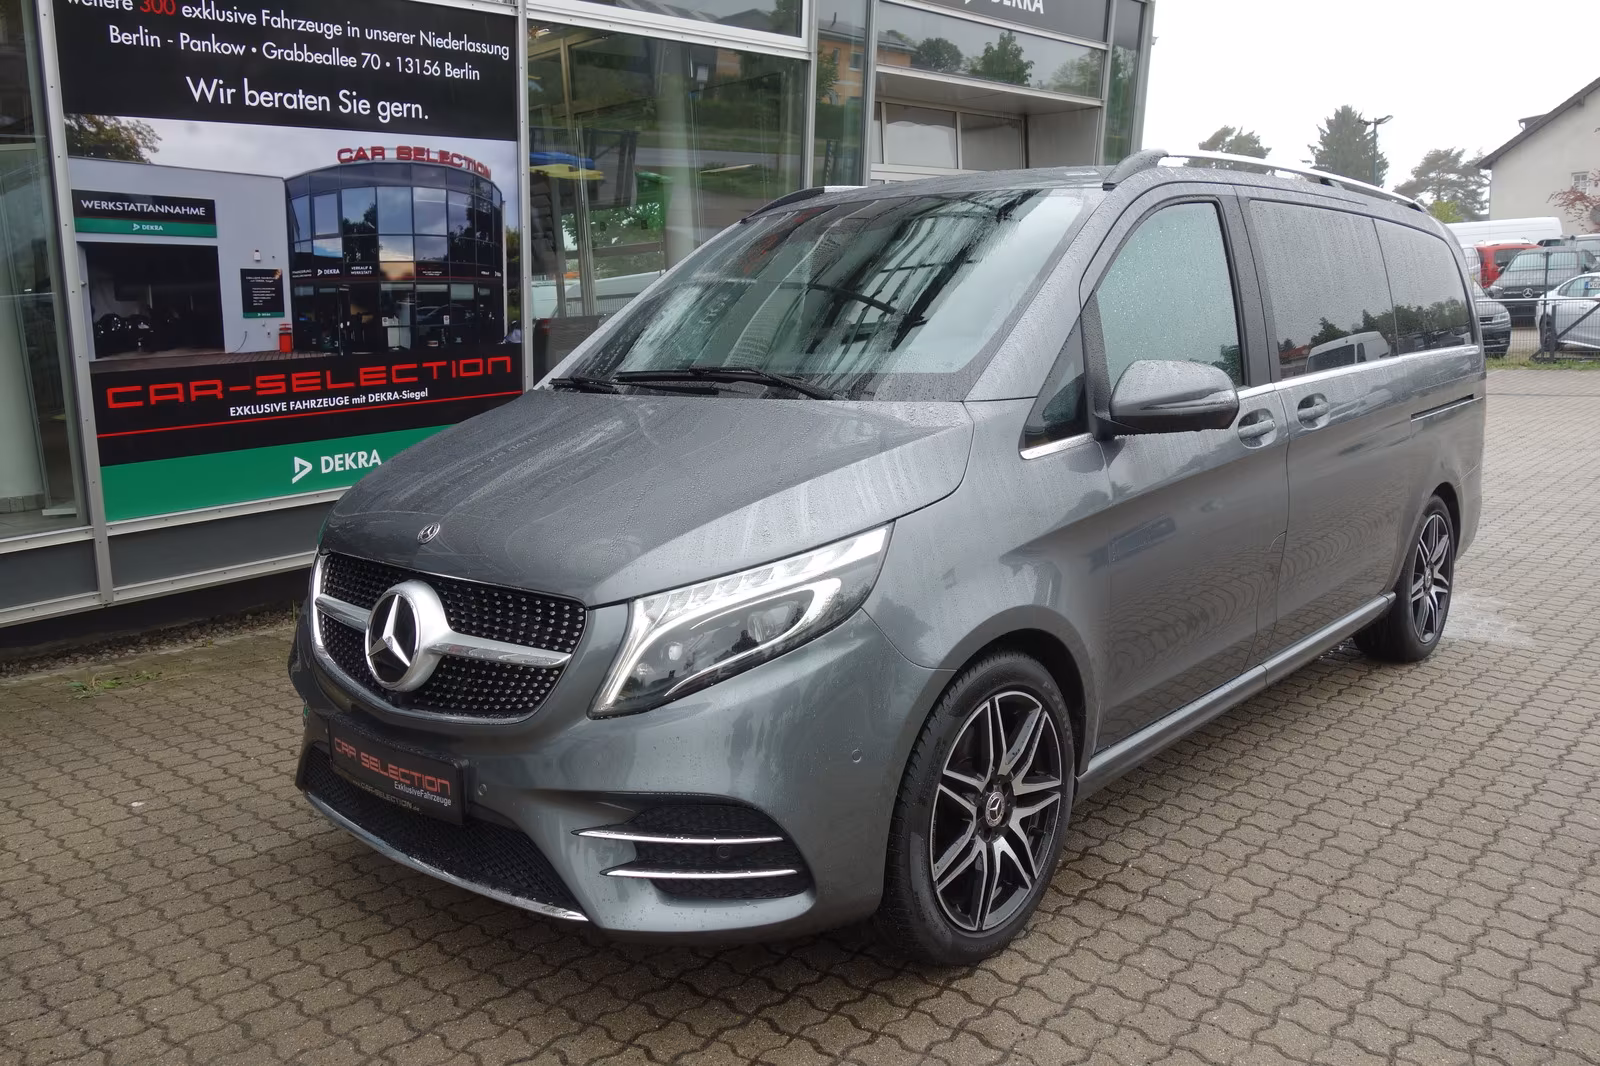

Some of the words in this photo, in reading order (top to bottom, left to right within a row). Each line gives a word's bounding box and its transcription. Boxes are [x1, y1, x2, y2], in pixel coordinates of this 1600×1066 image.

[140, 0, 176, 15] 300
[182, 1, 257, 26] exklusive
[262, 9, 342, 40] Fahrzeuge
[347, 21, 360, 38] in
[365, 28, 416, 45] unserer
[420, 30, 510, 60] Niederlassung
[109, 25, 161, 48] Berlin
[180, 33, 246, 56] Pankow
[262, 42, 357, 68] Grabbeallee
[361, 52, 381, 70] 70
[397, 56, 441, 77] 13156
[445, 62, 480, 81] Berlin
[186, 76, 236, 104] Wir
[244, 78, 331, 112] beraten
[338, 89, 371, 115] Sie
[377, 100, 429, 124] gern.
[337, 146, 386, 164] CAR
[396, 145, 492, 181] SELECTION
[81, 199, 206, 216] WERKSTATTANNAHME
[229, 402, 287, 417] EXKLUSIVE
[289, 396, 350, 411] FAHRZEUGE
[352, 394, 366, 404] mit
[368, 388, 428, 403] DEKRA-Siegel
[320, 449, 382, 474] DEKRA
[334, 737, 358, 762] CAR
[361, 751, 452, 796] SELECTION
